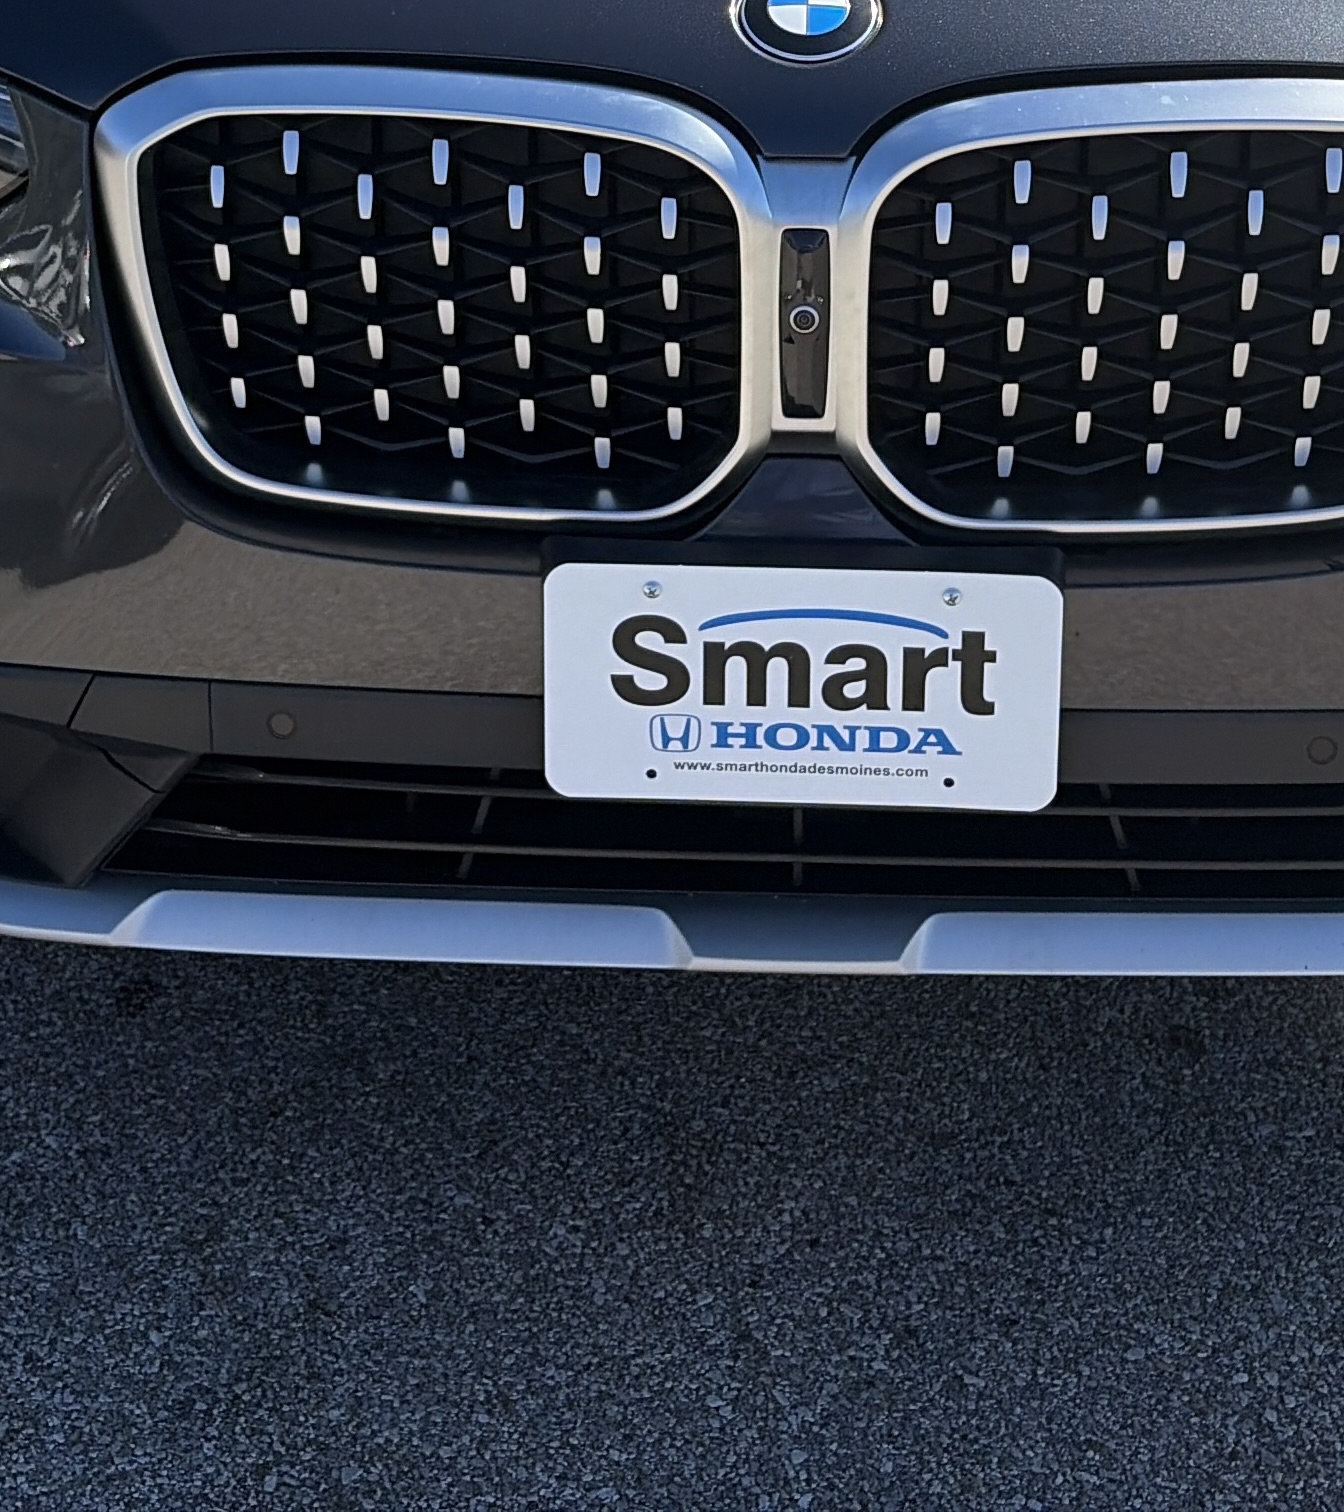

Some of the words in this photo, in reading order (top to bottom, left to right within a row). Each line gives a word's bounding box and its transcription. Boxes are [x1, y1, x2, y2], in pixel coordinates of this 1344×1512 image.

[610, 614, 997, 716] Smart
[710, 721, 963, 756] HONDA
[673, 759, 929, 778] www.smarthondadesmoines.com
